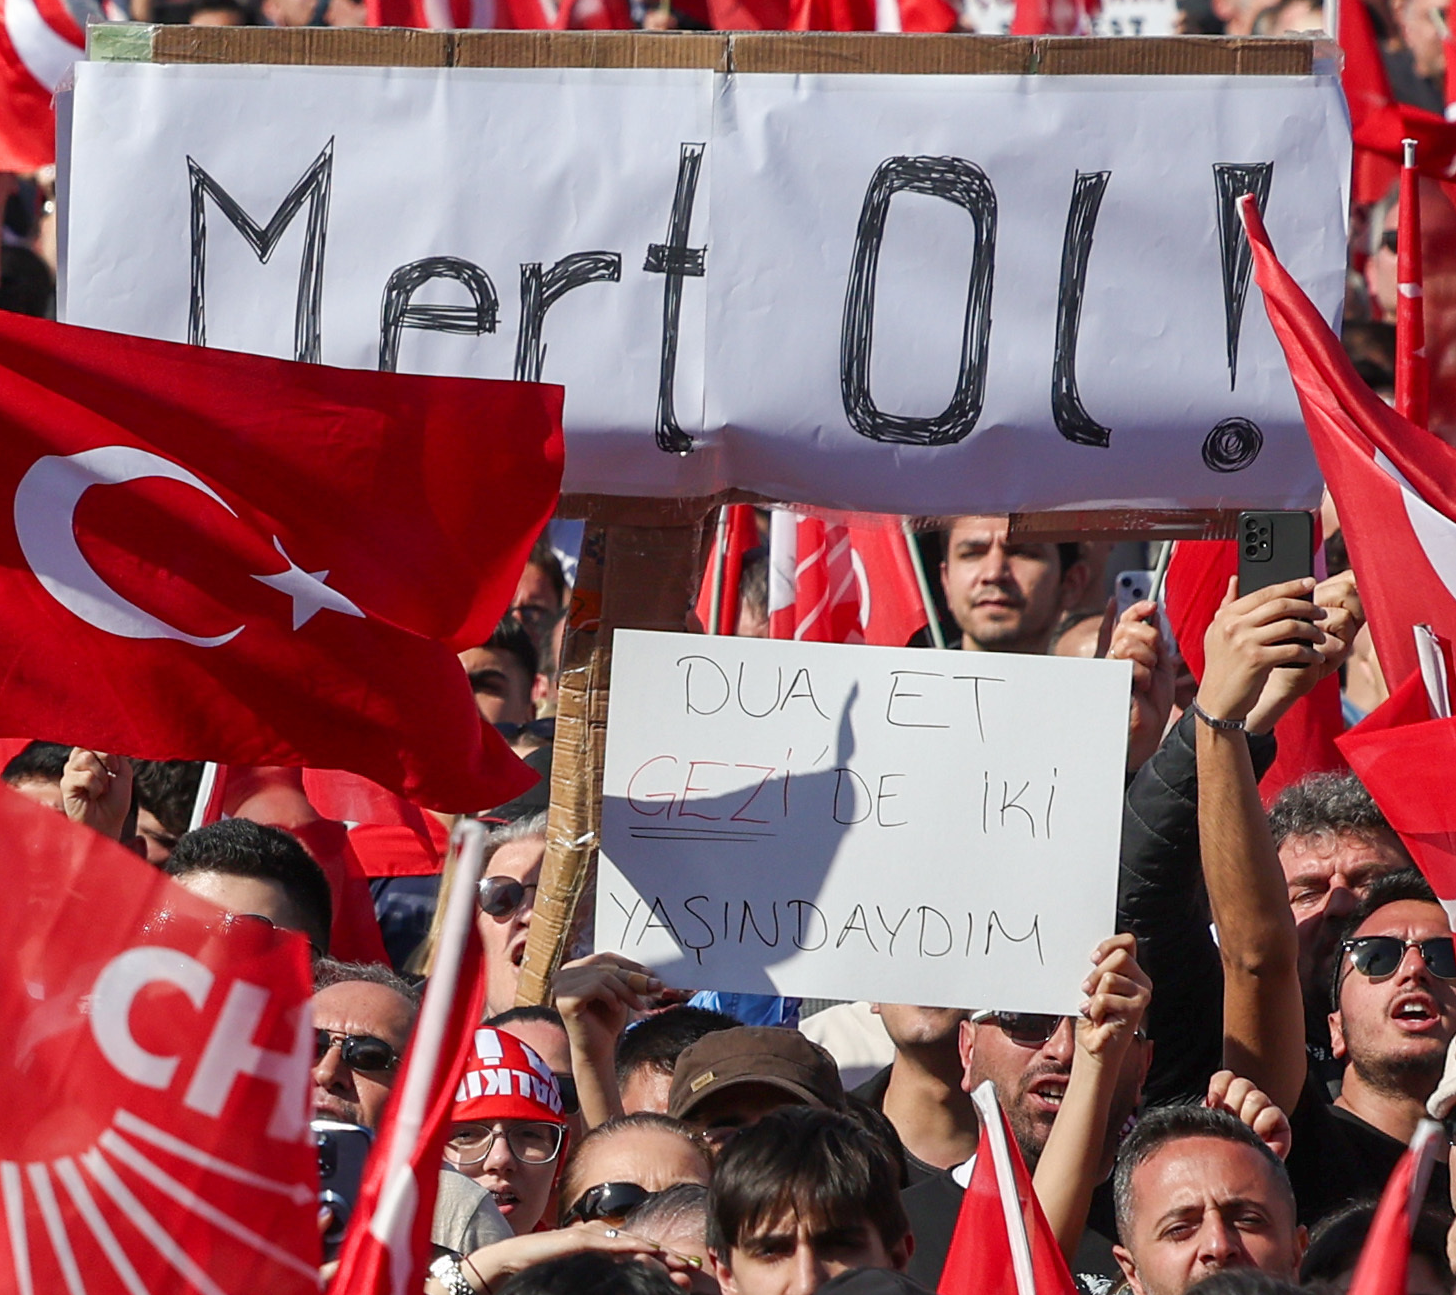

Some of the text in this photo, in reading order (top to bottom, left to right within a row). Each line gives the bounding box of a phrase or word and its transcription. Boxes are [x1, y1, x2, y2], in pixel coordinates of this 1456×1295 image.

[186, 135, 706, 453] Mert
[676, 656, 1006, 742] DUA ET
[609, 896, 1045, 966] YAŞINDAYDIM
[89, 945, 317, 1143] CH
